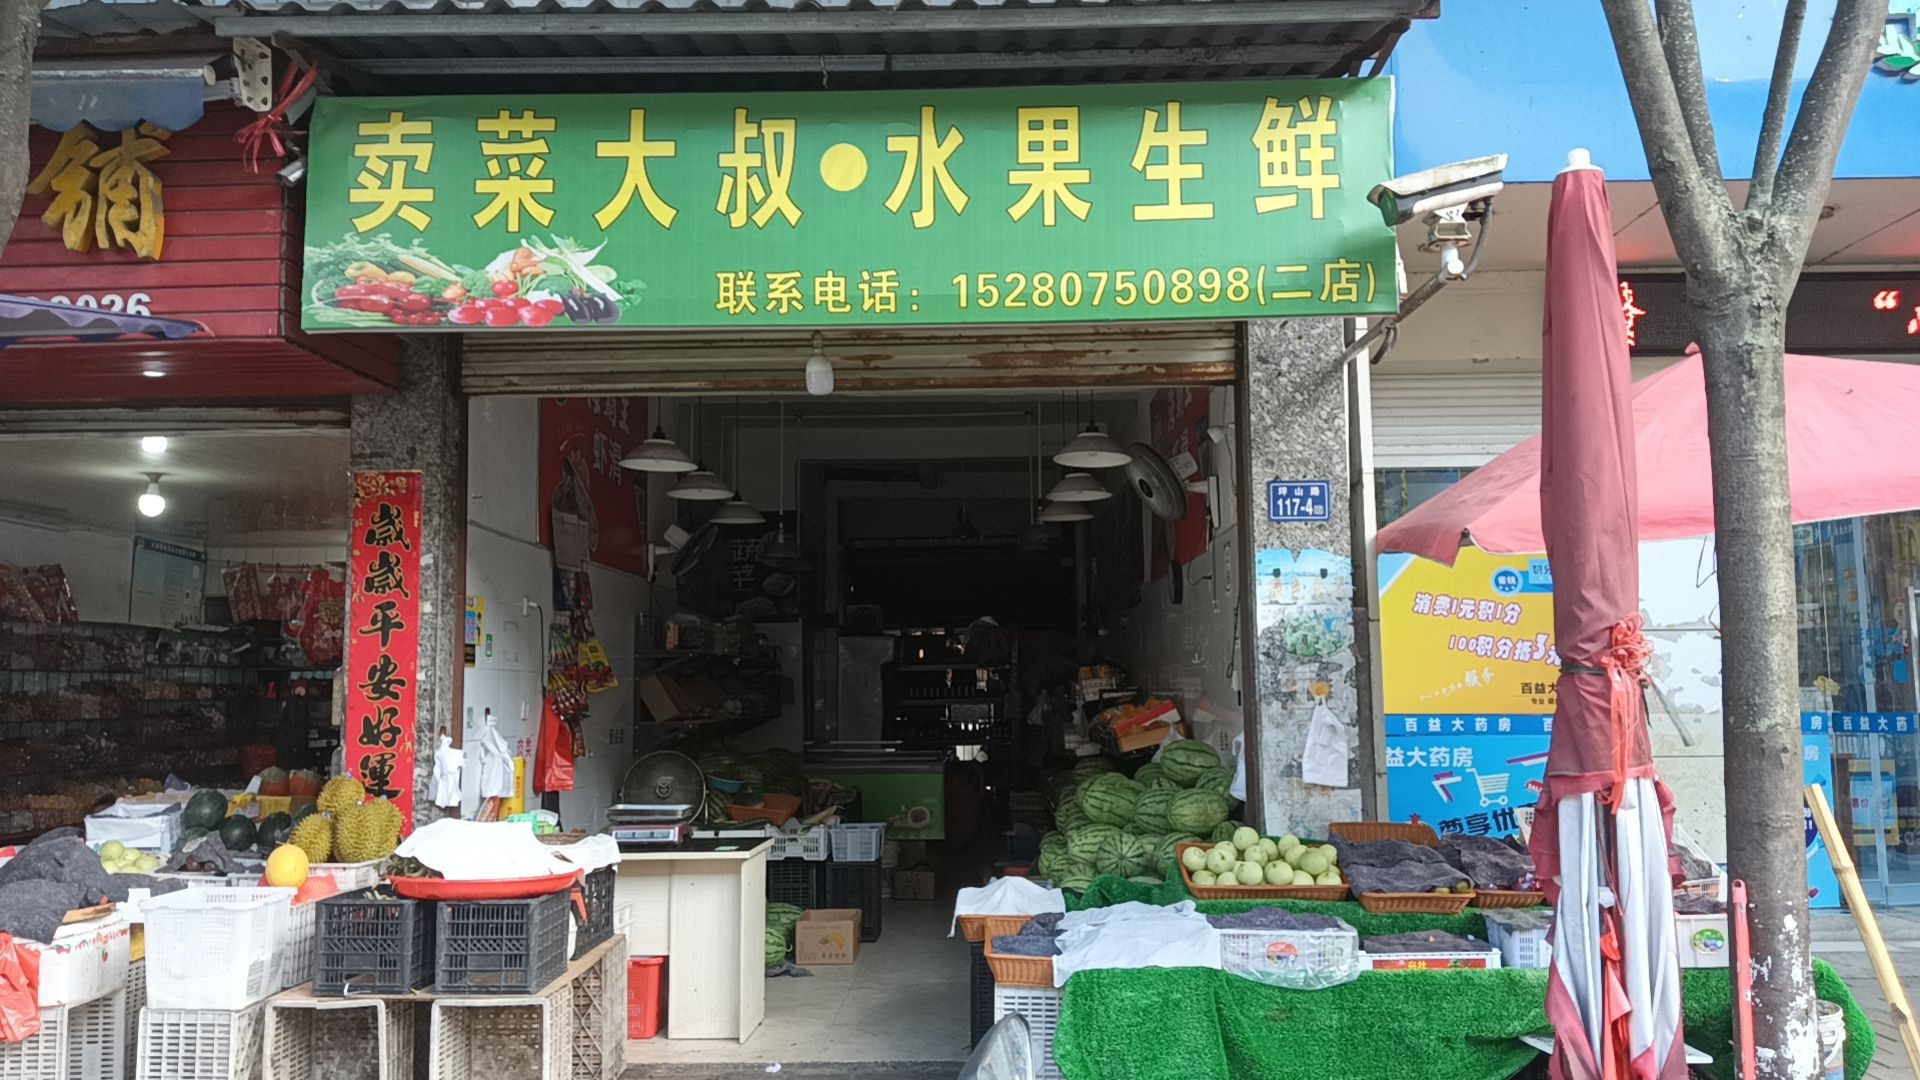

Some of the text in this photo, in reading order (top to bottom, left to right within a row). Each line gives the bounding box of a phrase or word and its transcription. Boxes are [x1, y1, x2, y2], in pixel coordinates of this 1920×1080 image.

[1414, 593, 1522, 625] 消费1元积1分
[1405, 717, 1512, 732] 百益大药房
